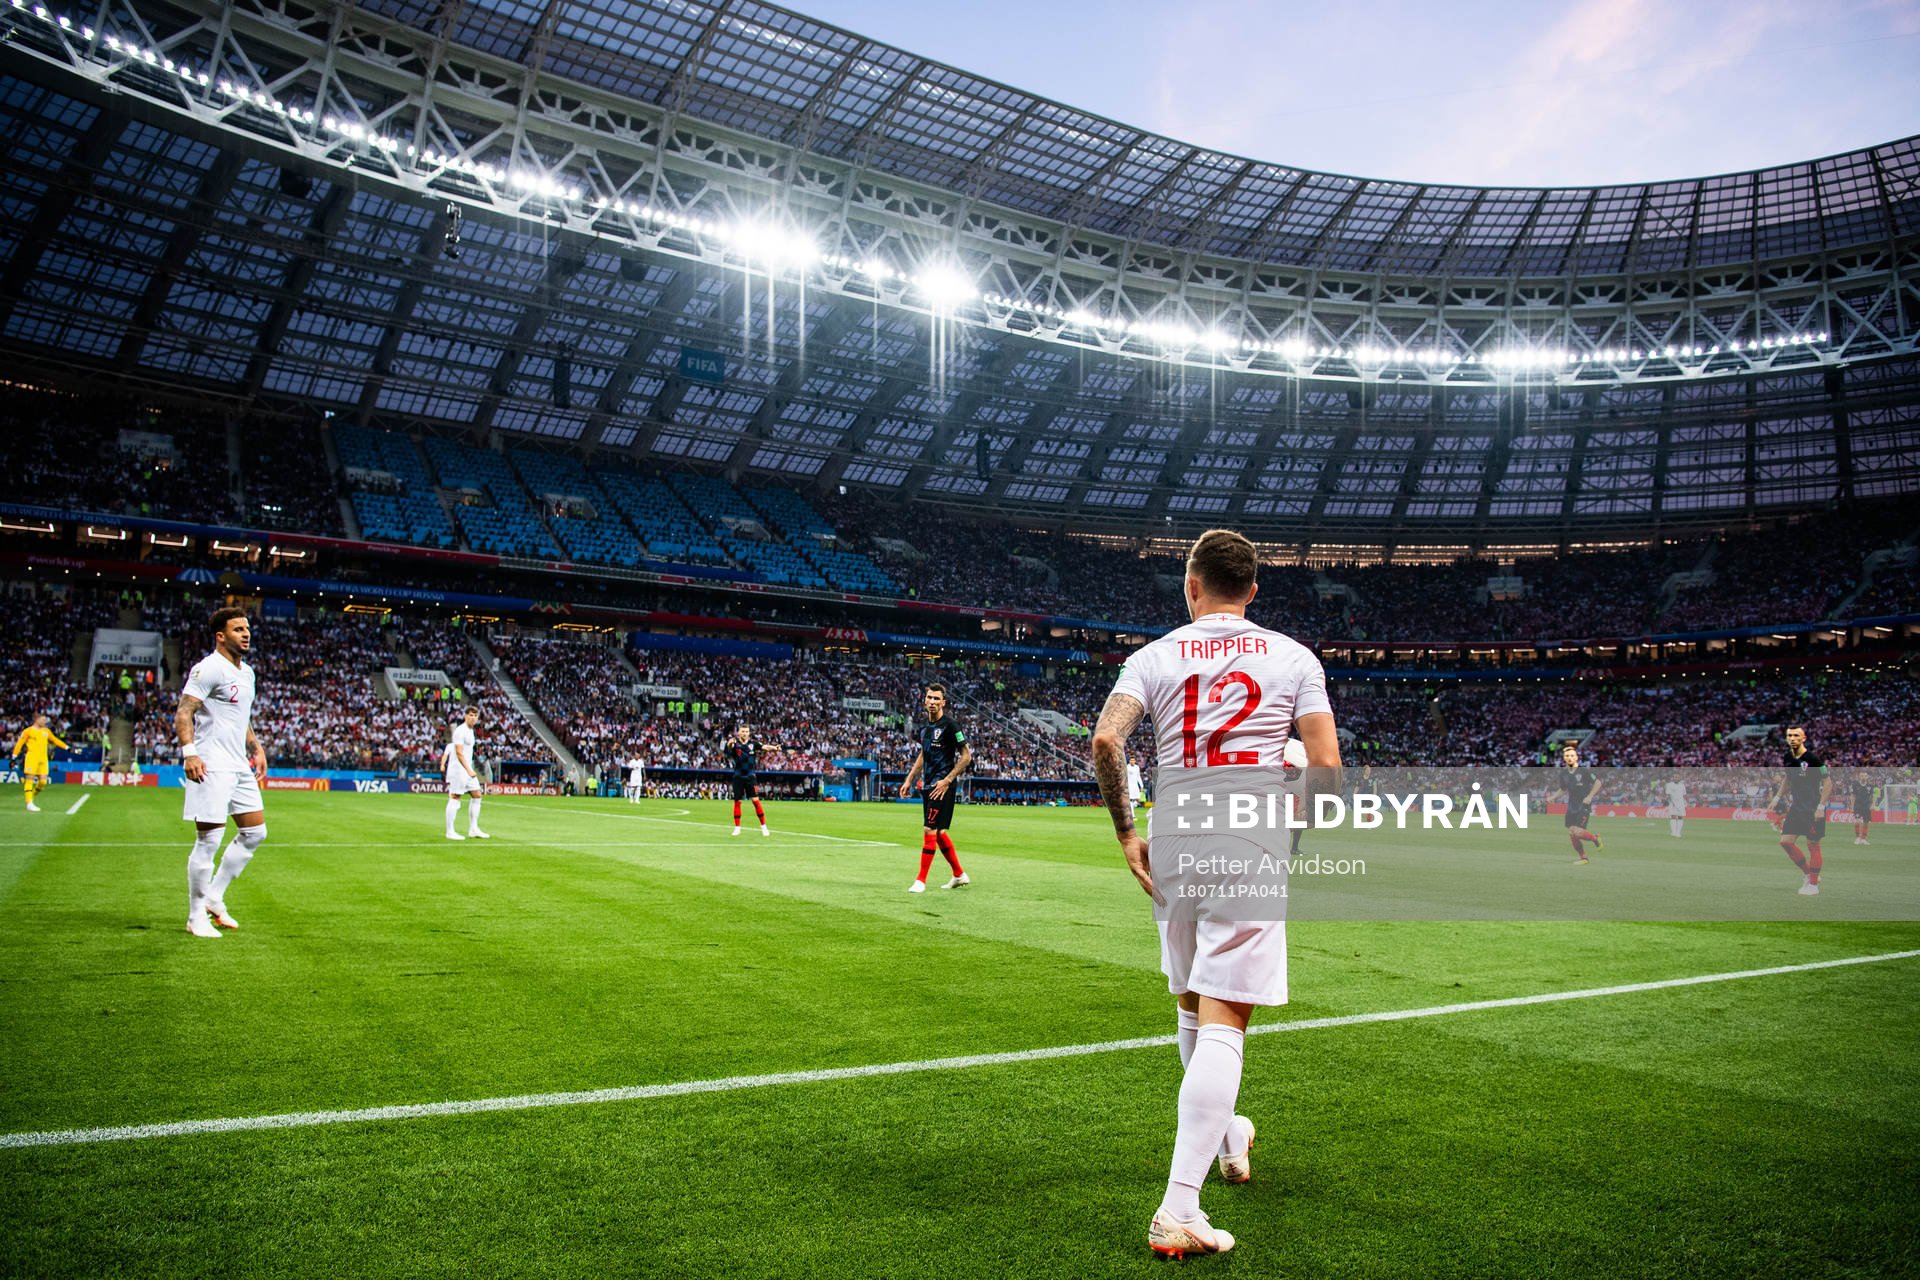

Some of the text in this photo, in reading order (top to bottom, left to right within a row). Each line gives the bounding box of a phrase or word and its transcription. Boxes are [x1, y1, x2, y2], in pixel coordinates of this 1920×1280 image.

[687, 356, 718, 373] FIFA
[413, 591, 445, 601] RUSSIA
[1177, 637, 1267, 659] TRIPPIER
[229, 685, 241, 703] 2
[1182, 671, 1262, 768] 12
[353, 779, 390, 793] VISA
[411, 782, 444, 794] QATAR
[504, 785, 520, 795] KIA
[927, 807, 941, 821] 17
